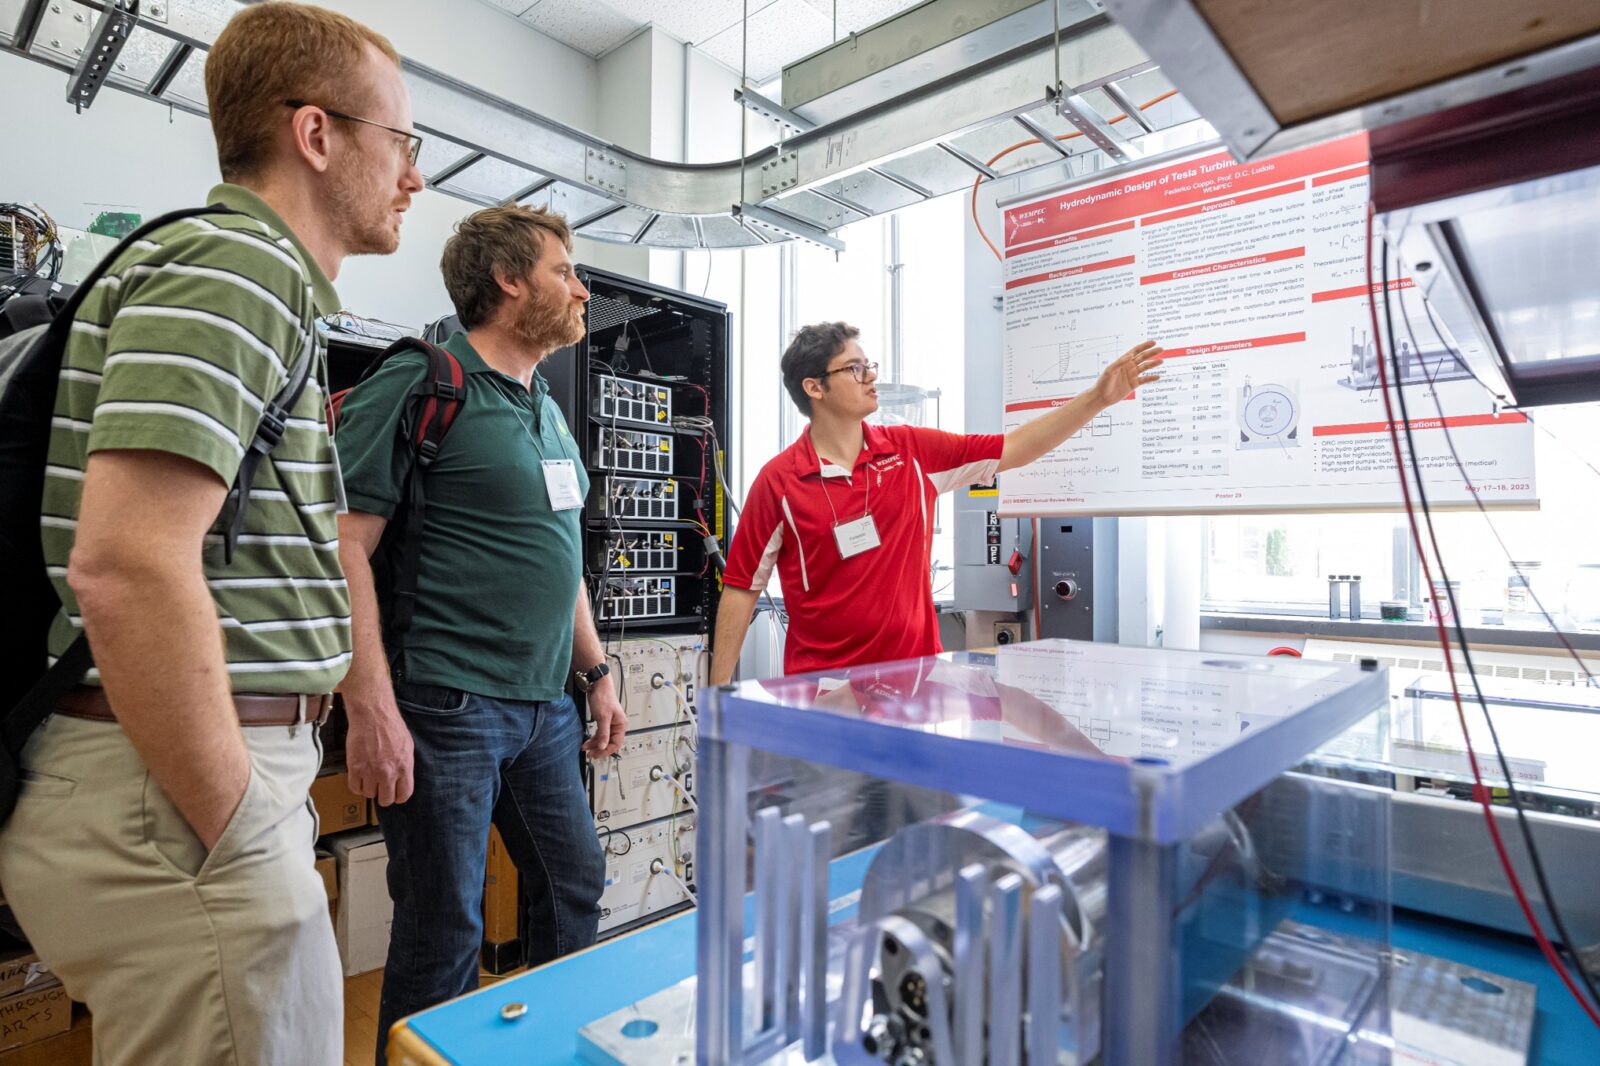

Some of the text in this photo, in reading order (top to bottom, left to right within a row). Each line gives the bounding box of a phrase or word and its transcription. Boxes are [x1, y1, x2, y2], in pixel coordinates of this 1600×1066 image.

[1060, 189, 1121, 210] Hydrodynamic
[1125, 180, 1156, 192] Design
[1160, 174, 1170, 184] of
[1172, 168, 1196, 181] Tesla
[1164, 184, 1191, 196] Federico
[1217, 174, 1232, 184] Prof.
[1234, 170, 1250, 180] D.C.
[1202, 181, 1232, 194] WEMPEC
[1201, 199, 1236, 212] Approach
[1020, 208, 1046, 220] WEMPEC
[1233, 225, 1263, 235] parameters
[1312, 226, 1331, 234] Torque
[1342, 220, 1359, 228] single
[1054, 236, 1077, 245] Benefits
[1172, 256, 1266, 279] Experiment Characteristics
[1313, 258, 1344, 268] Theoretical
[1048, 268, 1083, 279] Background
[1186, 341, 1252, 356] Design Parameters
[1354, 444, 1385, 452] generation
[876, 454, 900, 466] WEMPEC
[1352, 450, 1392, 459] high-viscosity
[1465, 459, 1496, 467] (medical)
